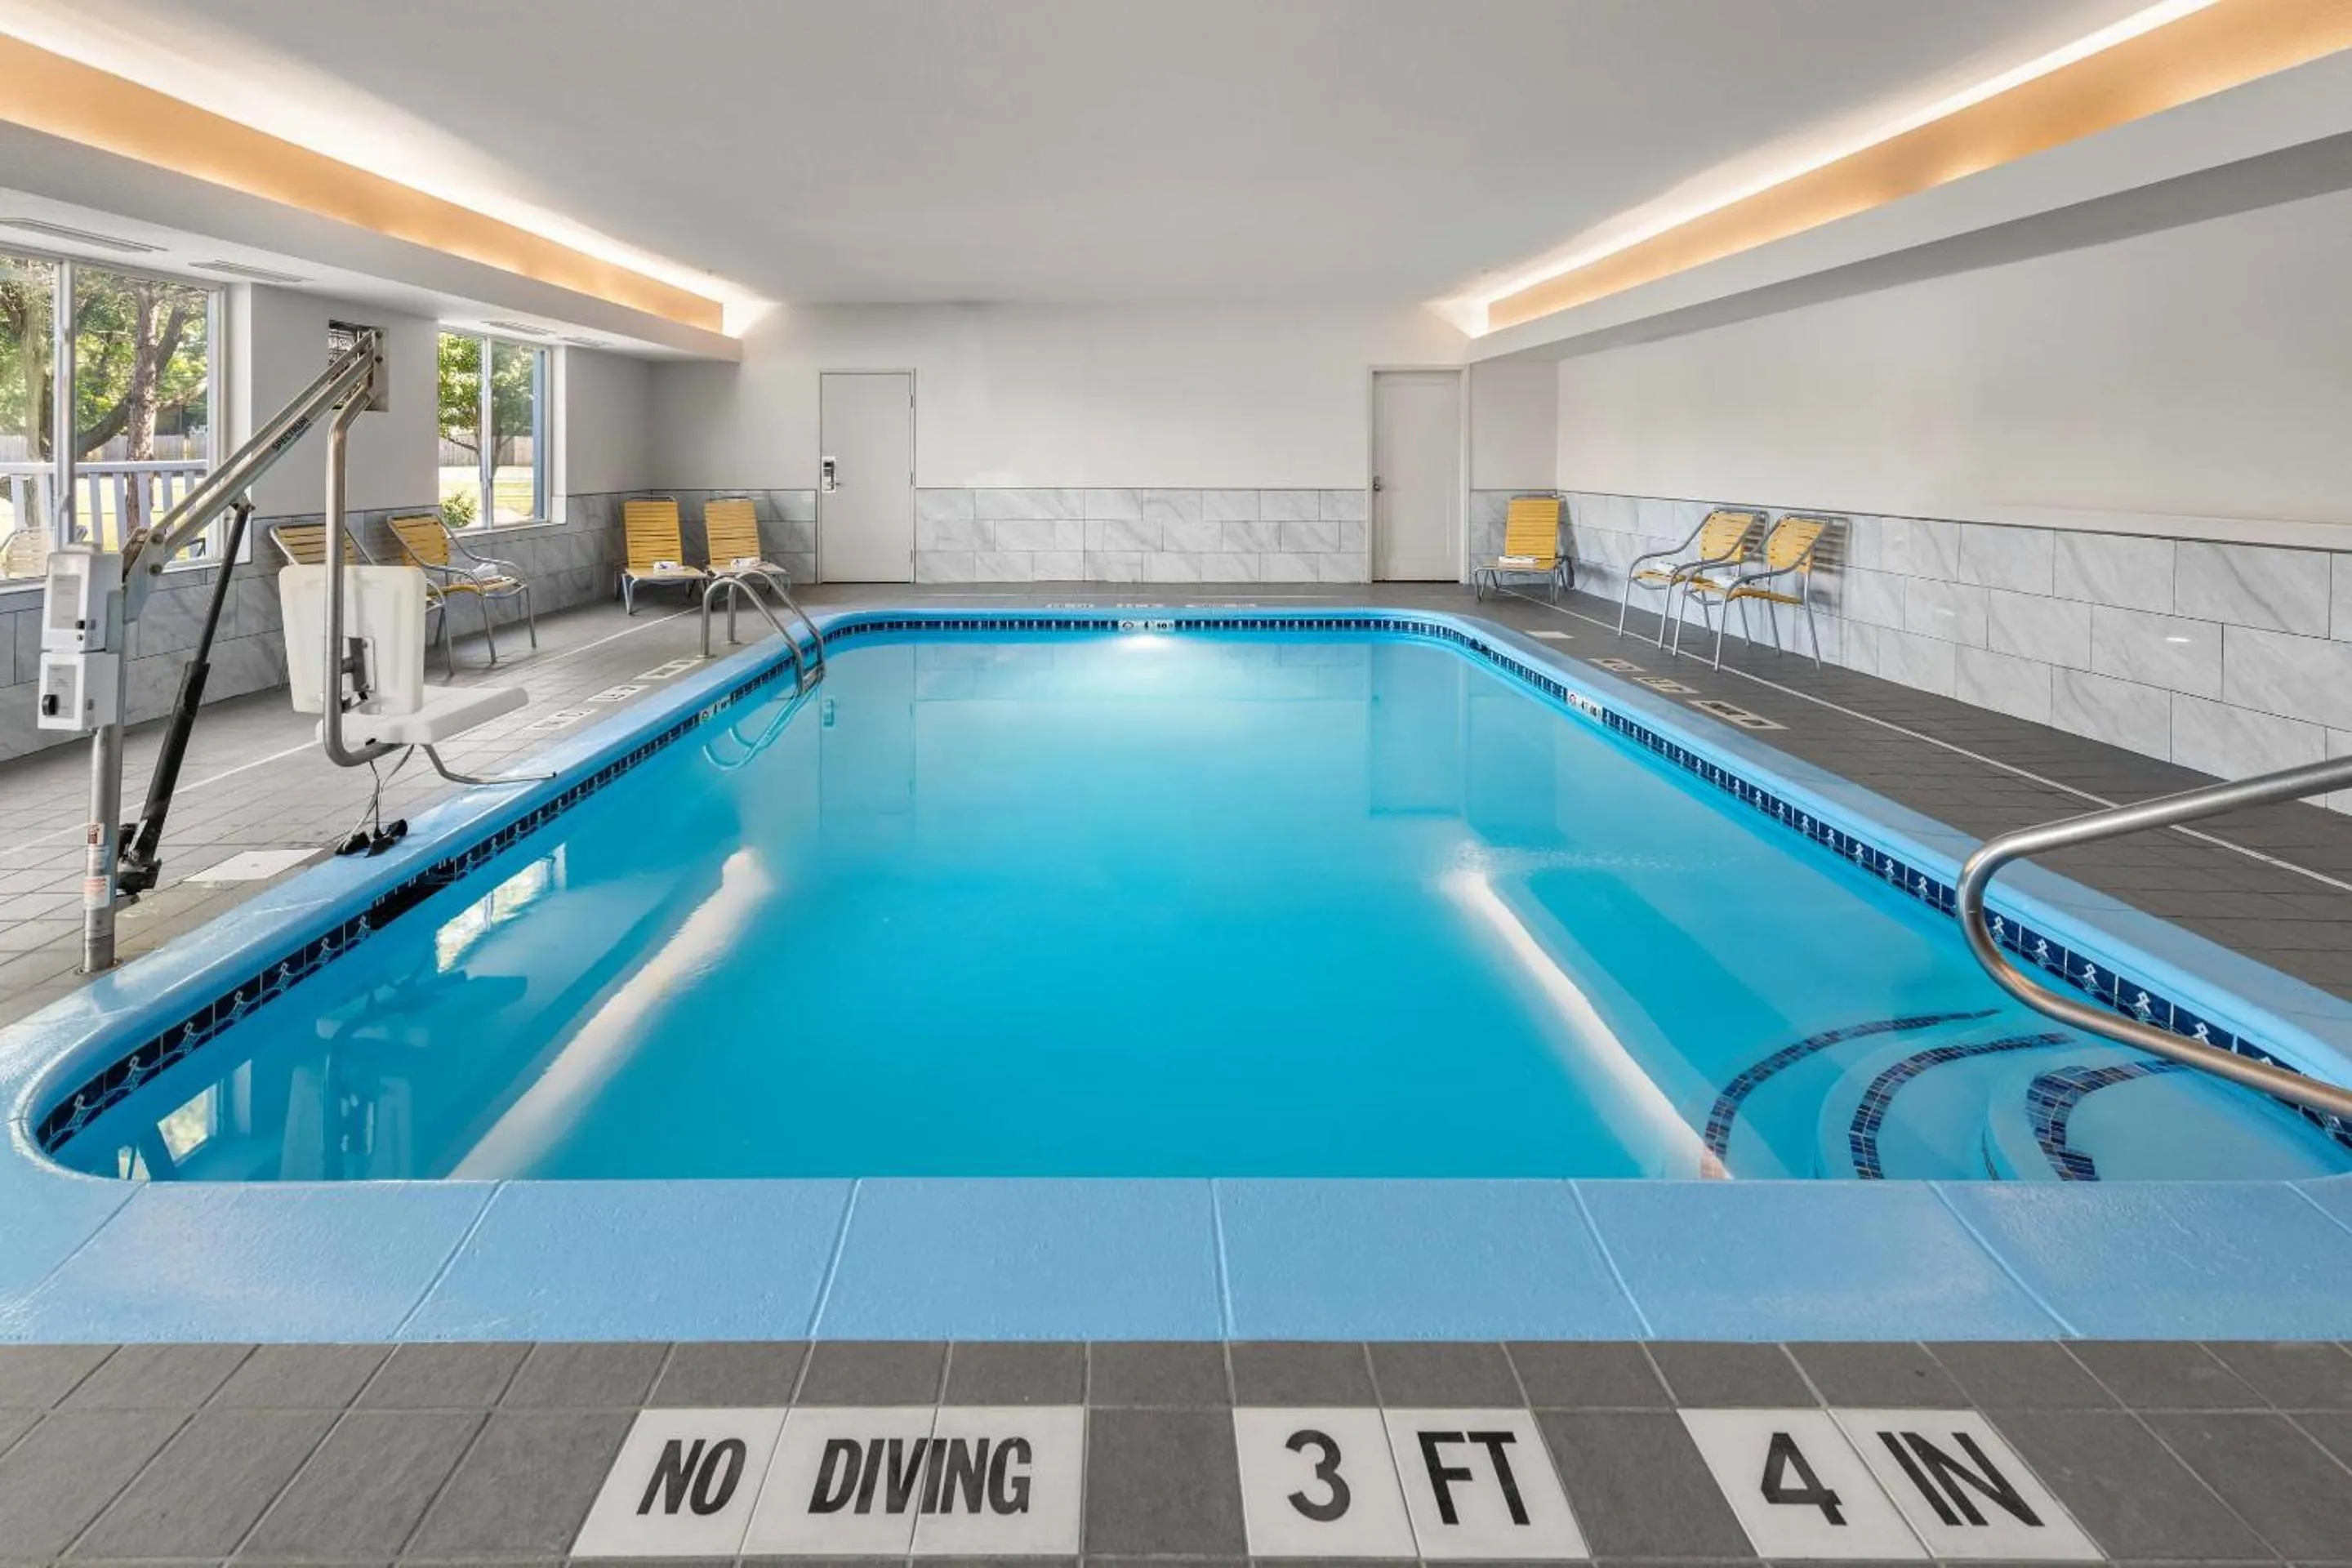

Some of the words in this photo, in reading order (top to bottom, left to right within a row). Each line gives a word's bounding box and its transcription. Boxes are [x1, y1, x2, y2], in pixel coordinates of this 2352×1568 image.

[636, 1437, 746, 1515] NO
[808, 1437, 1032, 1516] DIVING
[1285, 1429, 1351, 1522] 3
[1417, 1432, 1530, 1525] FT
[1761, 1432, 1847, 1526] 4
[1877, 1432, 2045, 1526] IN
